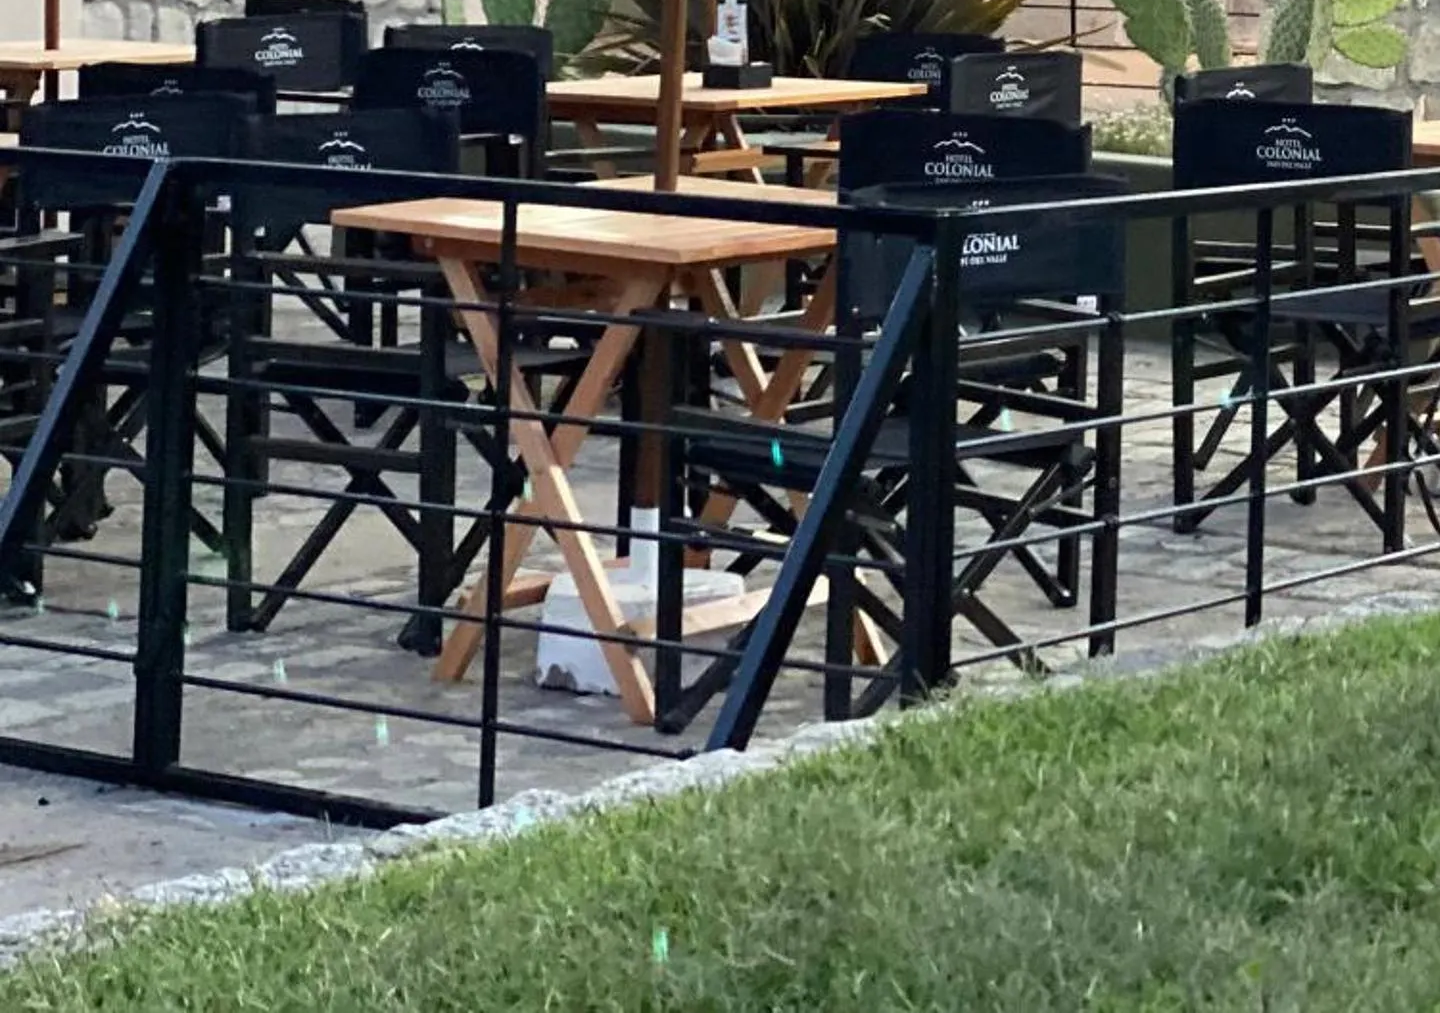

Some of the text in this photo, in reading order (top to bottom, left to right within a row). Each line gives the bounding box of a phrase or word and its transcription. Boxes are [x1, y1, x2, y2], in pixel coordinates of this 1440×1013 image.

[907, 68, 942, 80] COLONI
[1256, 145, 1323, 162] COLONIAL
[924, 161, 995, 178] COLONIAL
[962, 234, 1020, 255] LONIAL
